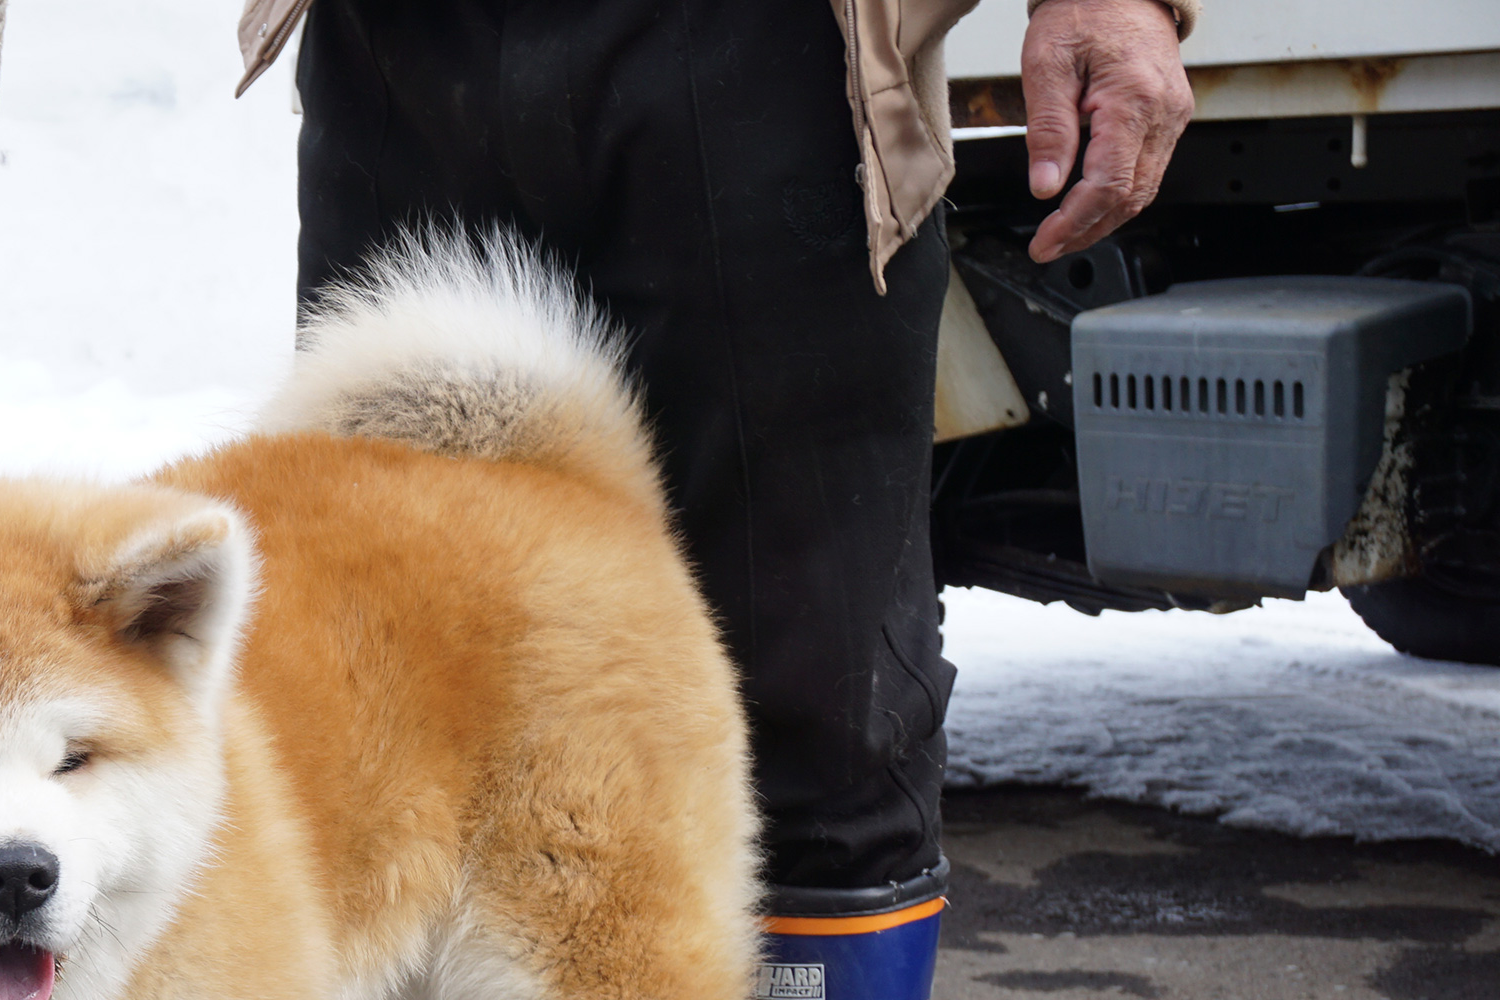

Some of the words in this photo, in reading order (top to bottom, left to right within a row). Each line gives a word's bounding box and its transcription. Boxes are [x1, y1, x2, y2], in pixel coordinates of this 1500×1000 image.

[1104, 474, 1294, 523] HIJET
[758, 967, 821, 997] HARD
[774, 988, 810, 996] IMPACT
